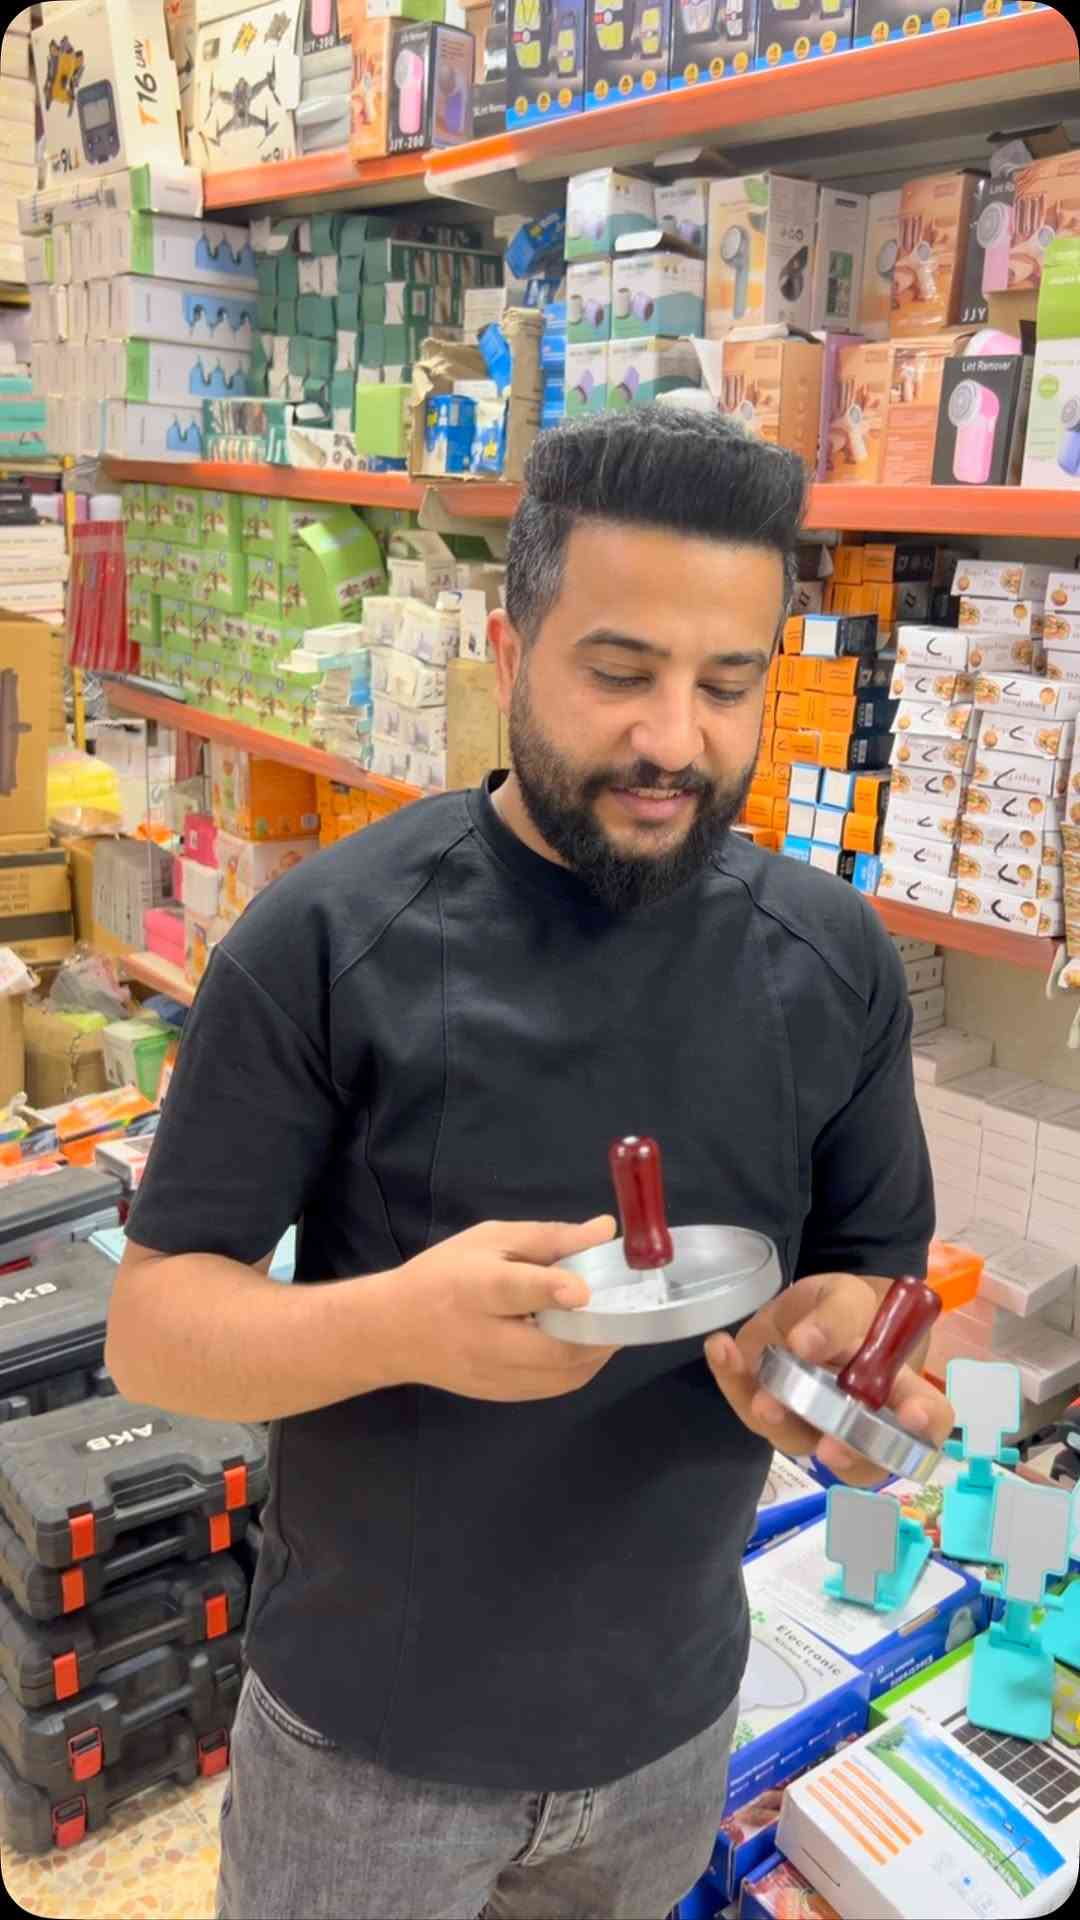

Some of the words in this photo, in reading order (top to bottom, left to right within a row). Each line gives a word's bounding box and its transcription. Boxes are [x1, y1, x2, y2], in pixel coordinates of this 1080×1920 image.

[961, 307, 987, 322] JJY
[977, 360, 1010, 371] Remover
[86, 1423, 152, 1451] AKB
[776, 1624, 841, 1676] Electronic
